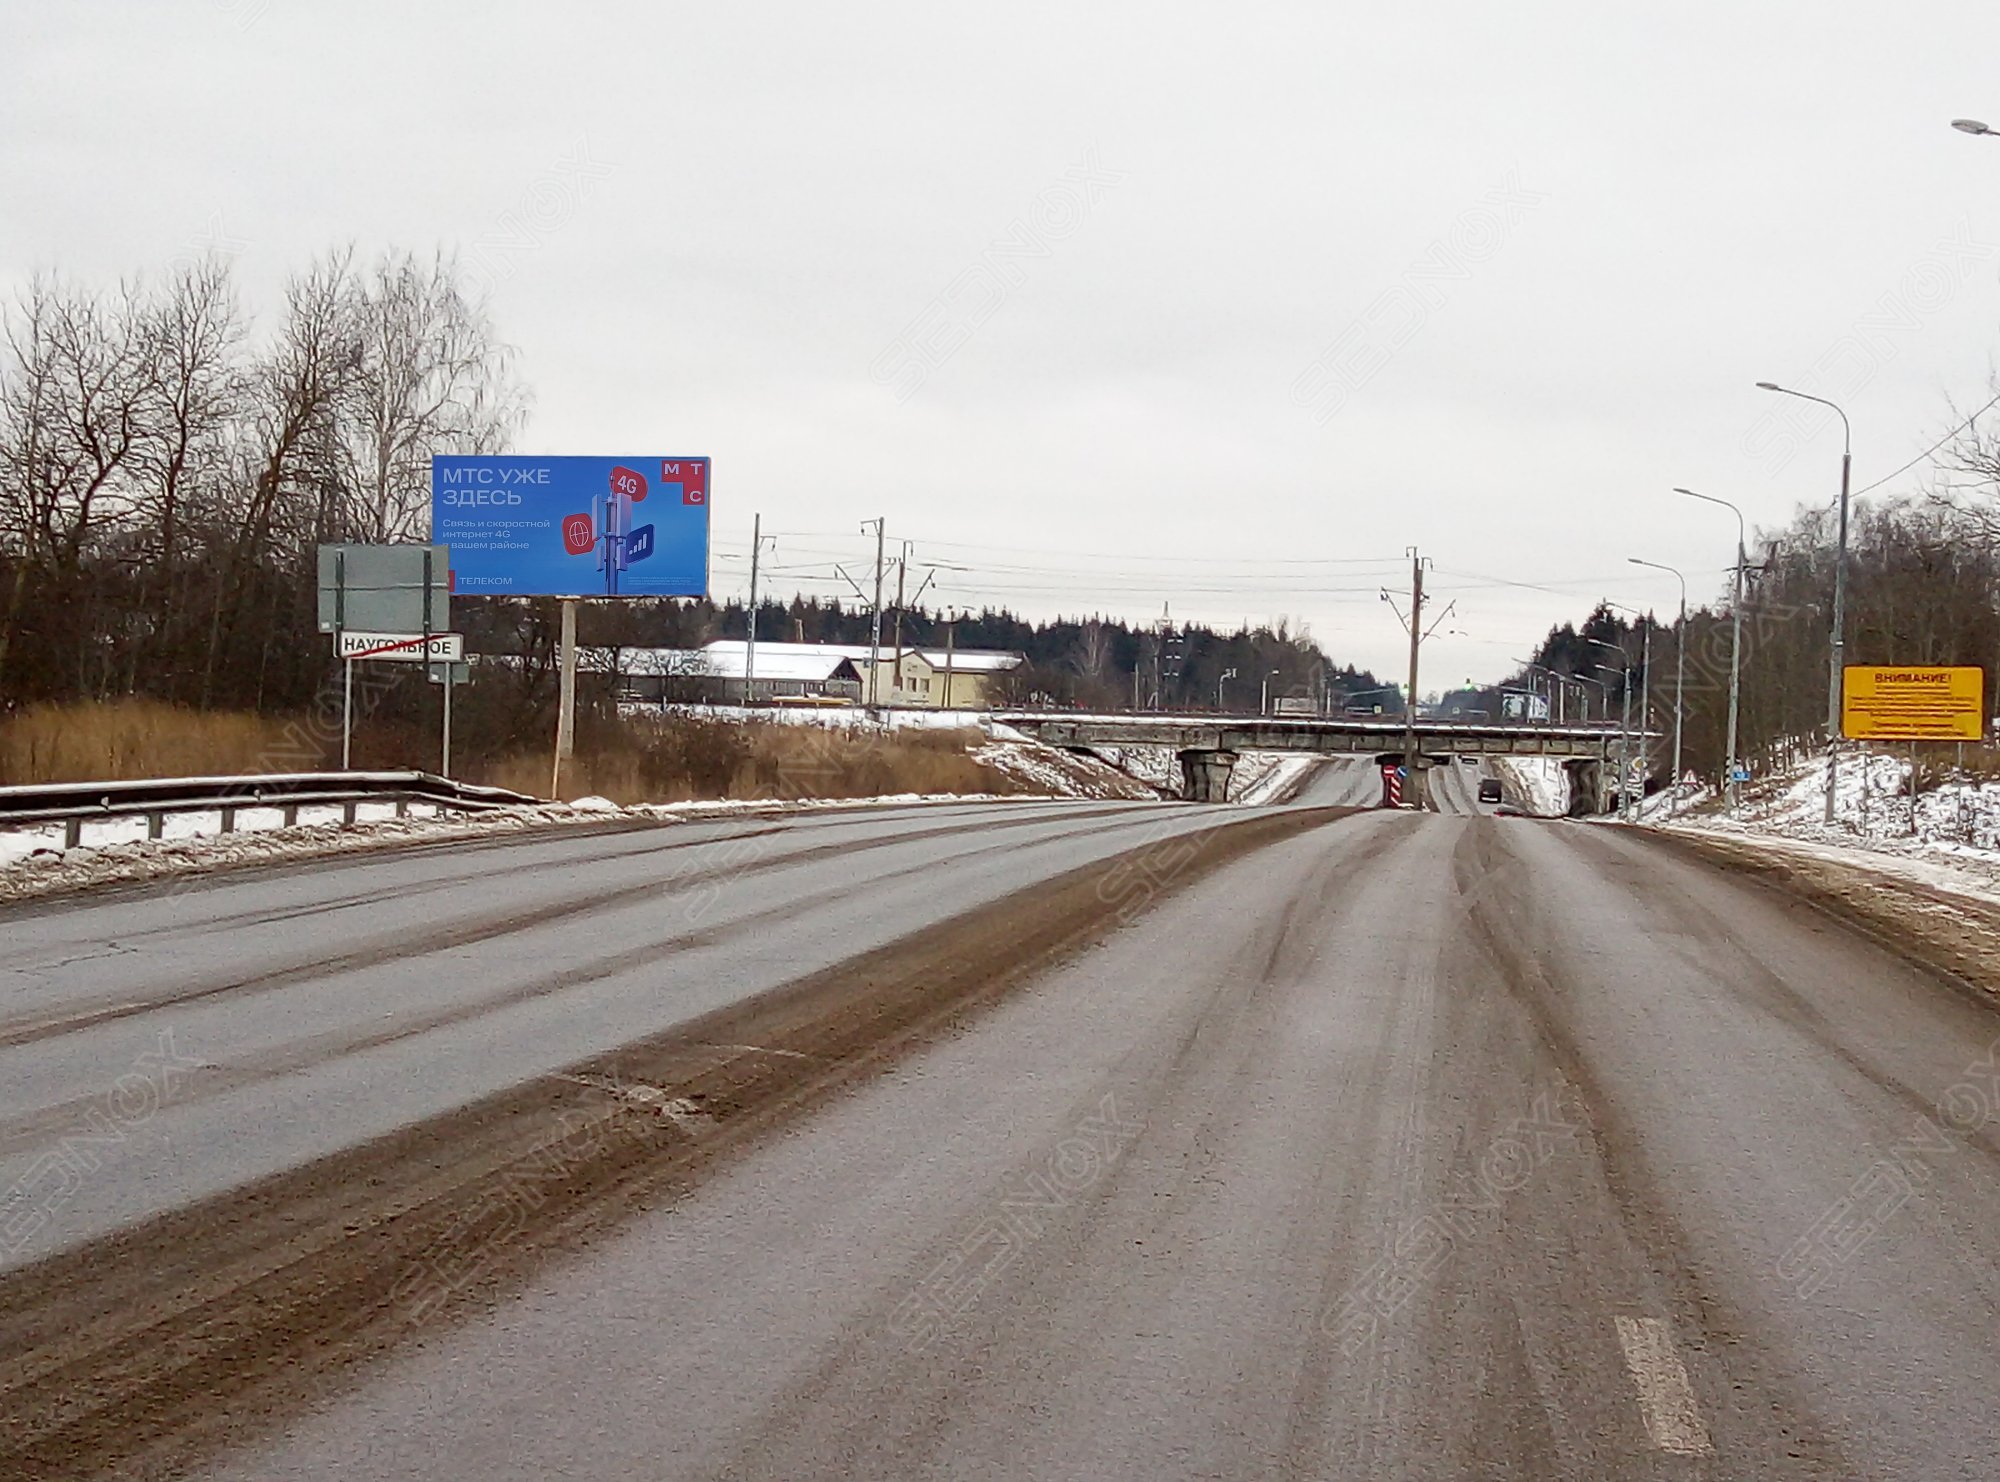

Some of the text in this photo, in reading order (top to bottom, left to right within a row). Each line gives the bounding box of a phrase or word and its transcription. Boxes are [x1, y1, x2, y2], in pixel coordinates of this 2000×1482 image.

[443, 468, 551, 484] МТС УЖЕ
[617, 475, 637, 494] 4G
[443, 489, 522, 508] ЗДЕСЬ
[442, 519, 476, 528] Связь
[486, 519, 551, 529] скоростной
[442, 530, 511, 540] интернет 4G
[490, 541, 530, 551] районе
[459, 577, 513, 585] ТЕЛЕКОМ
